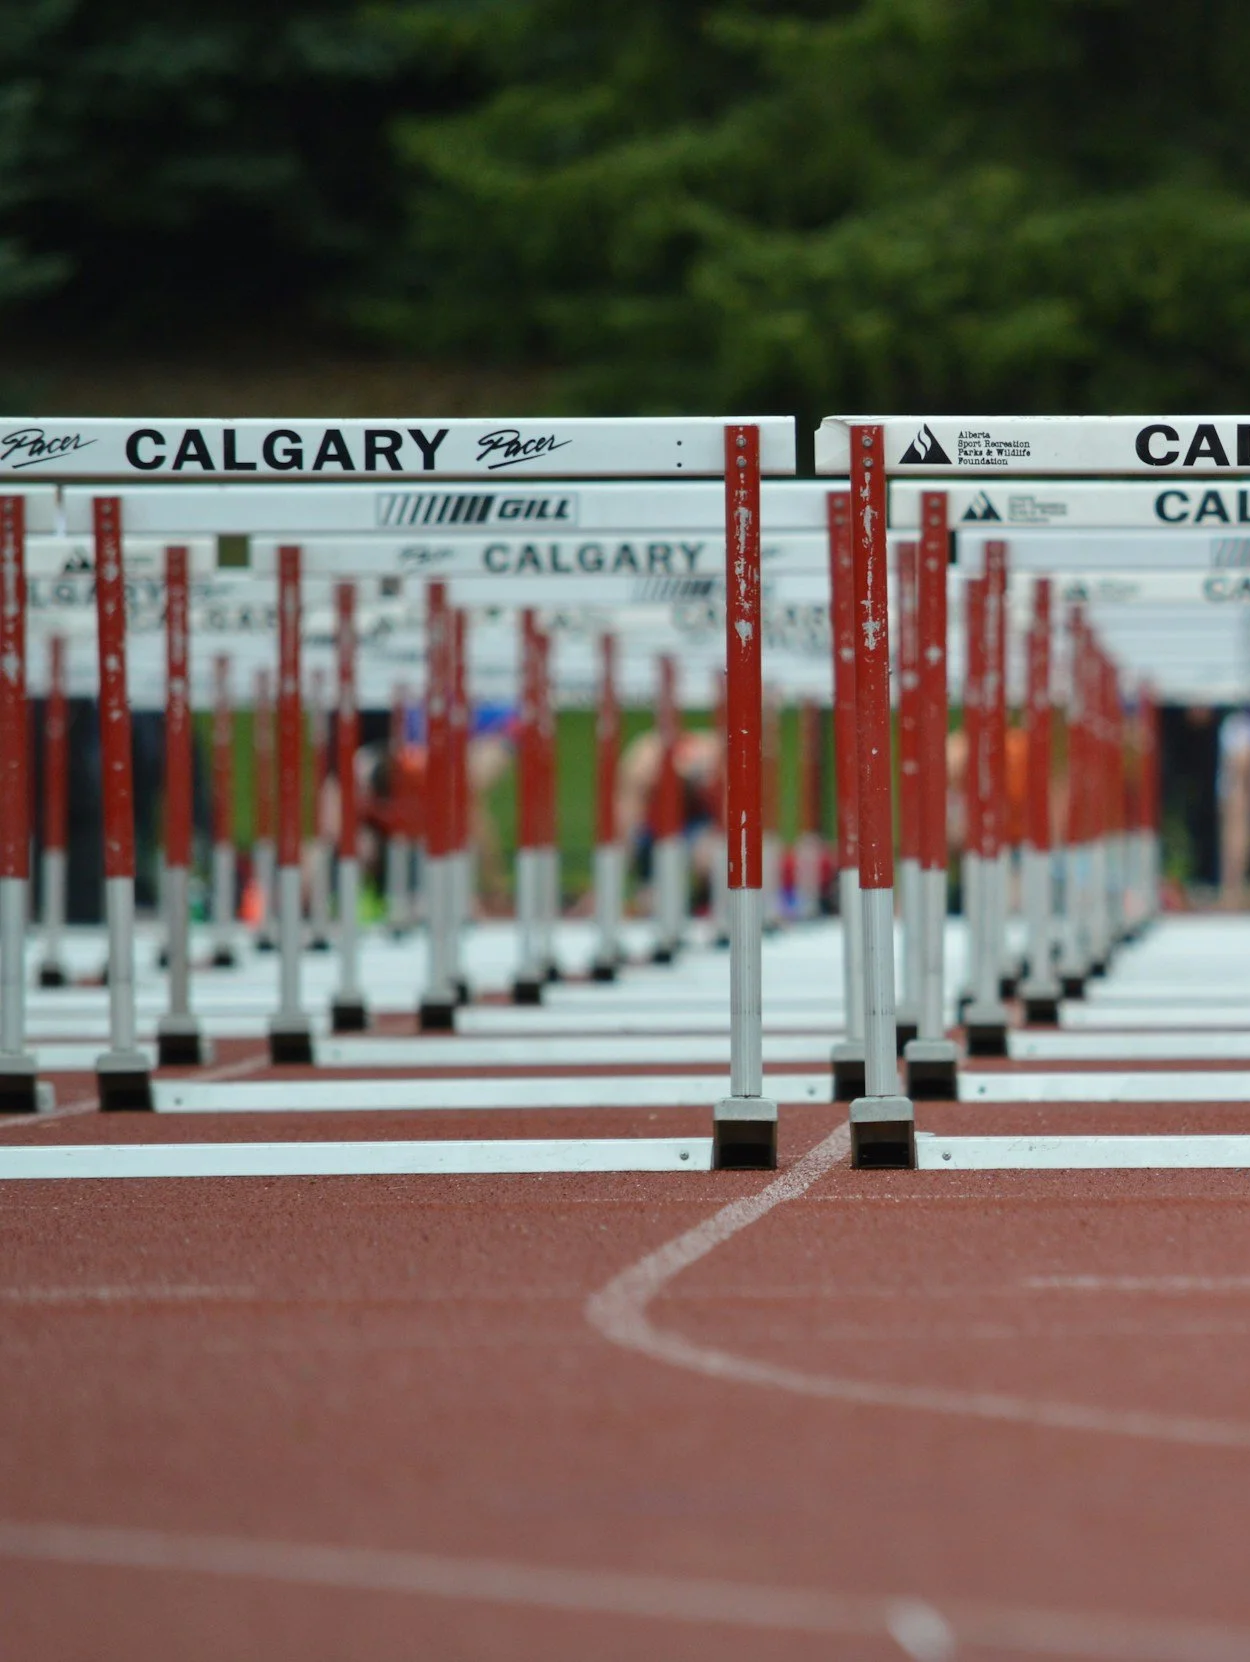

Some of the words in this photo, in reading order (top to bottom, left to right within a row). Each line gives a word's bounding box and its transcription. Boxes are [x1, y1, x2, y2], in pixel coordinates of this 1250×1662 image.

[958, 431, 991, 439] Alberta
[958, 440, 981, 448] Sport
[984, 440, 1030, 448] Recreation
[1, 429, 98, 468] Pacer
[126, 429, 449, 471] CALGARY
[476, 430, 572, 469] Pacer
[958, 449, 983, 457] Parks
[985, 449, 993, 457] &
[996, 448, 1031, 457] Wildlife
[958, 457, 1008, 465] Foundation
[498, 499, 569, 519] GILL
[484, 543, 704, 574] CALGARY
